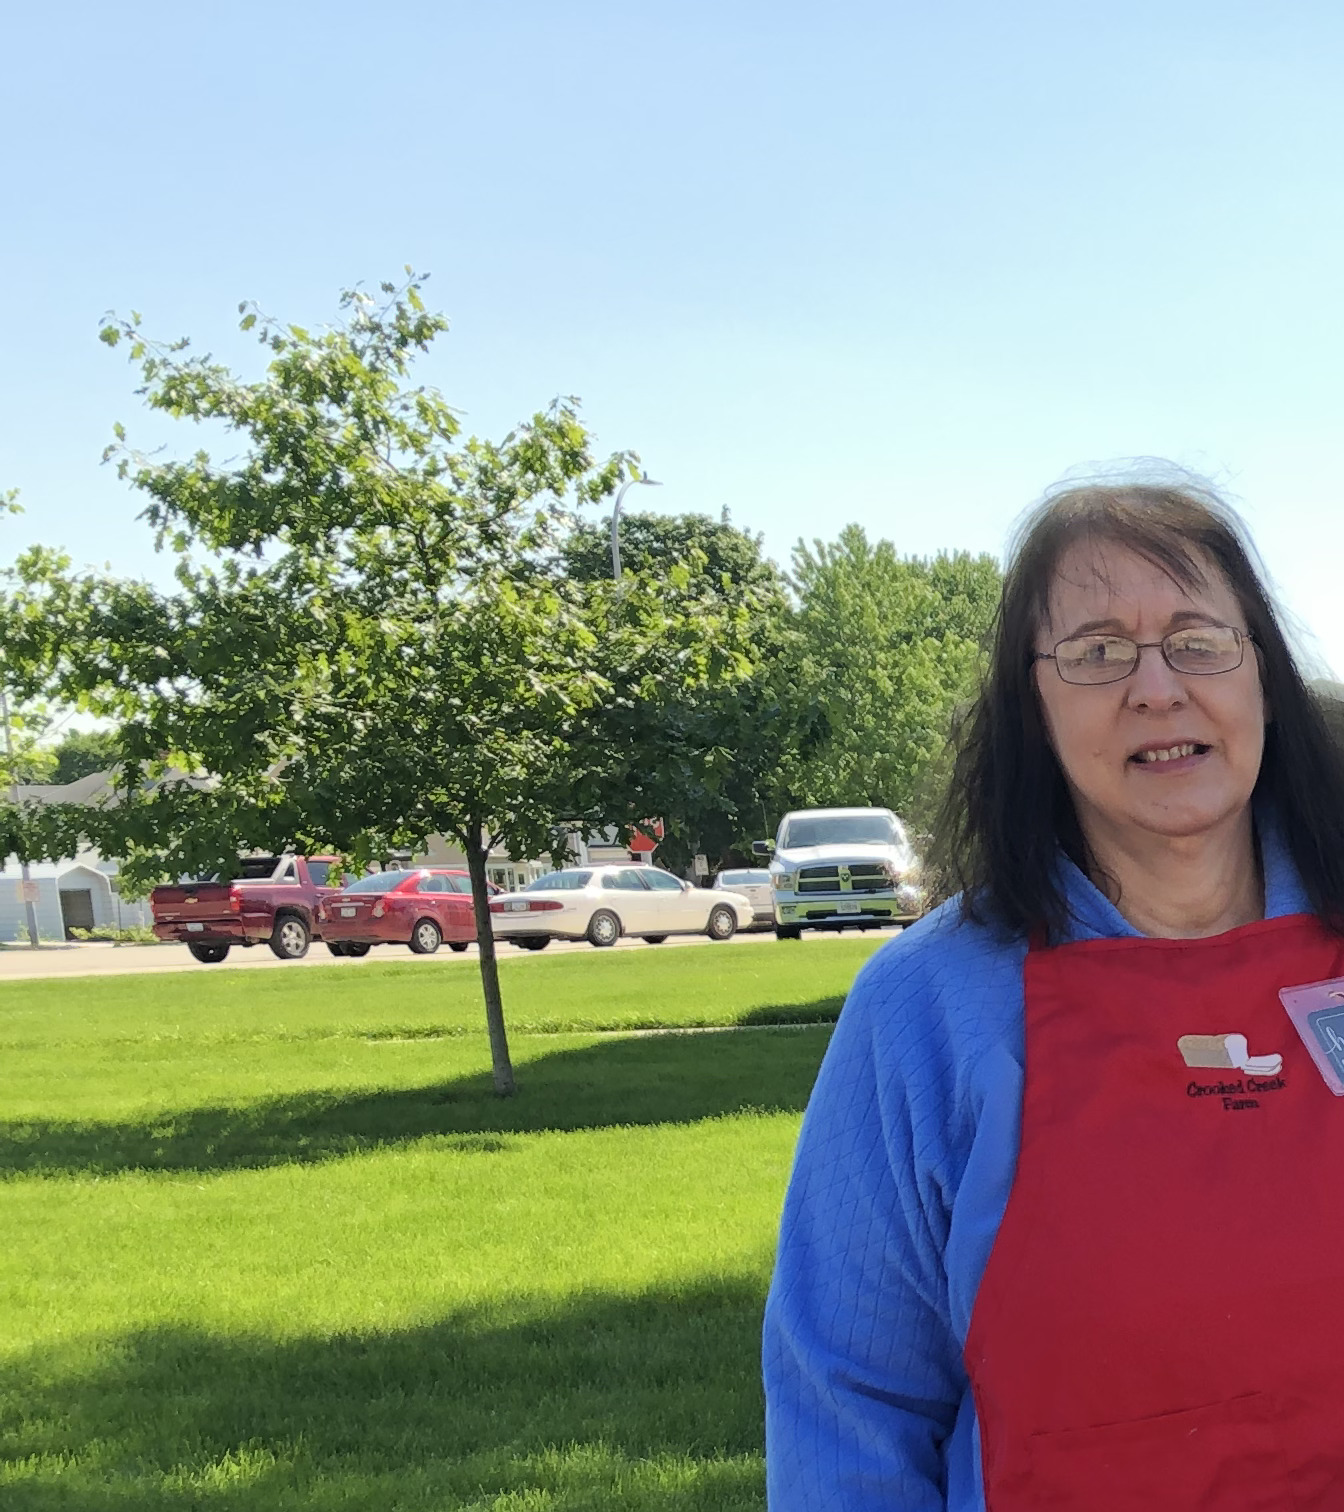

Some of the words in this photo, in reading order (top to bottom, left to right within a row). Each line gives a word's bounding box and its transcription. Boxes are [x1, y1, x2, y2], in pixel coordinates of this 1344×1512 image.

[1187, 1081, 1245, 1097] Crooked
[1247, 1077, 1286, 1092] Creek
[1222, 1098, 1259, 1110] Farm
